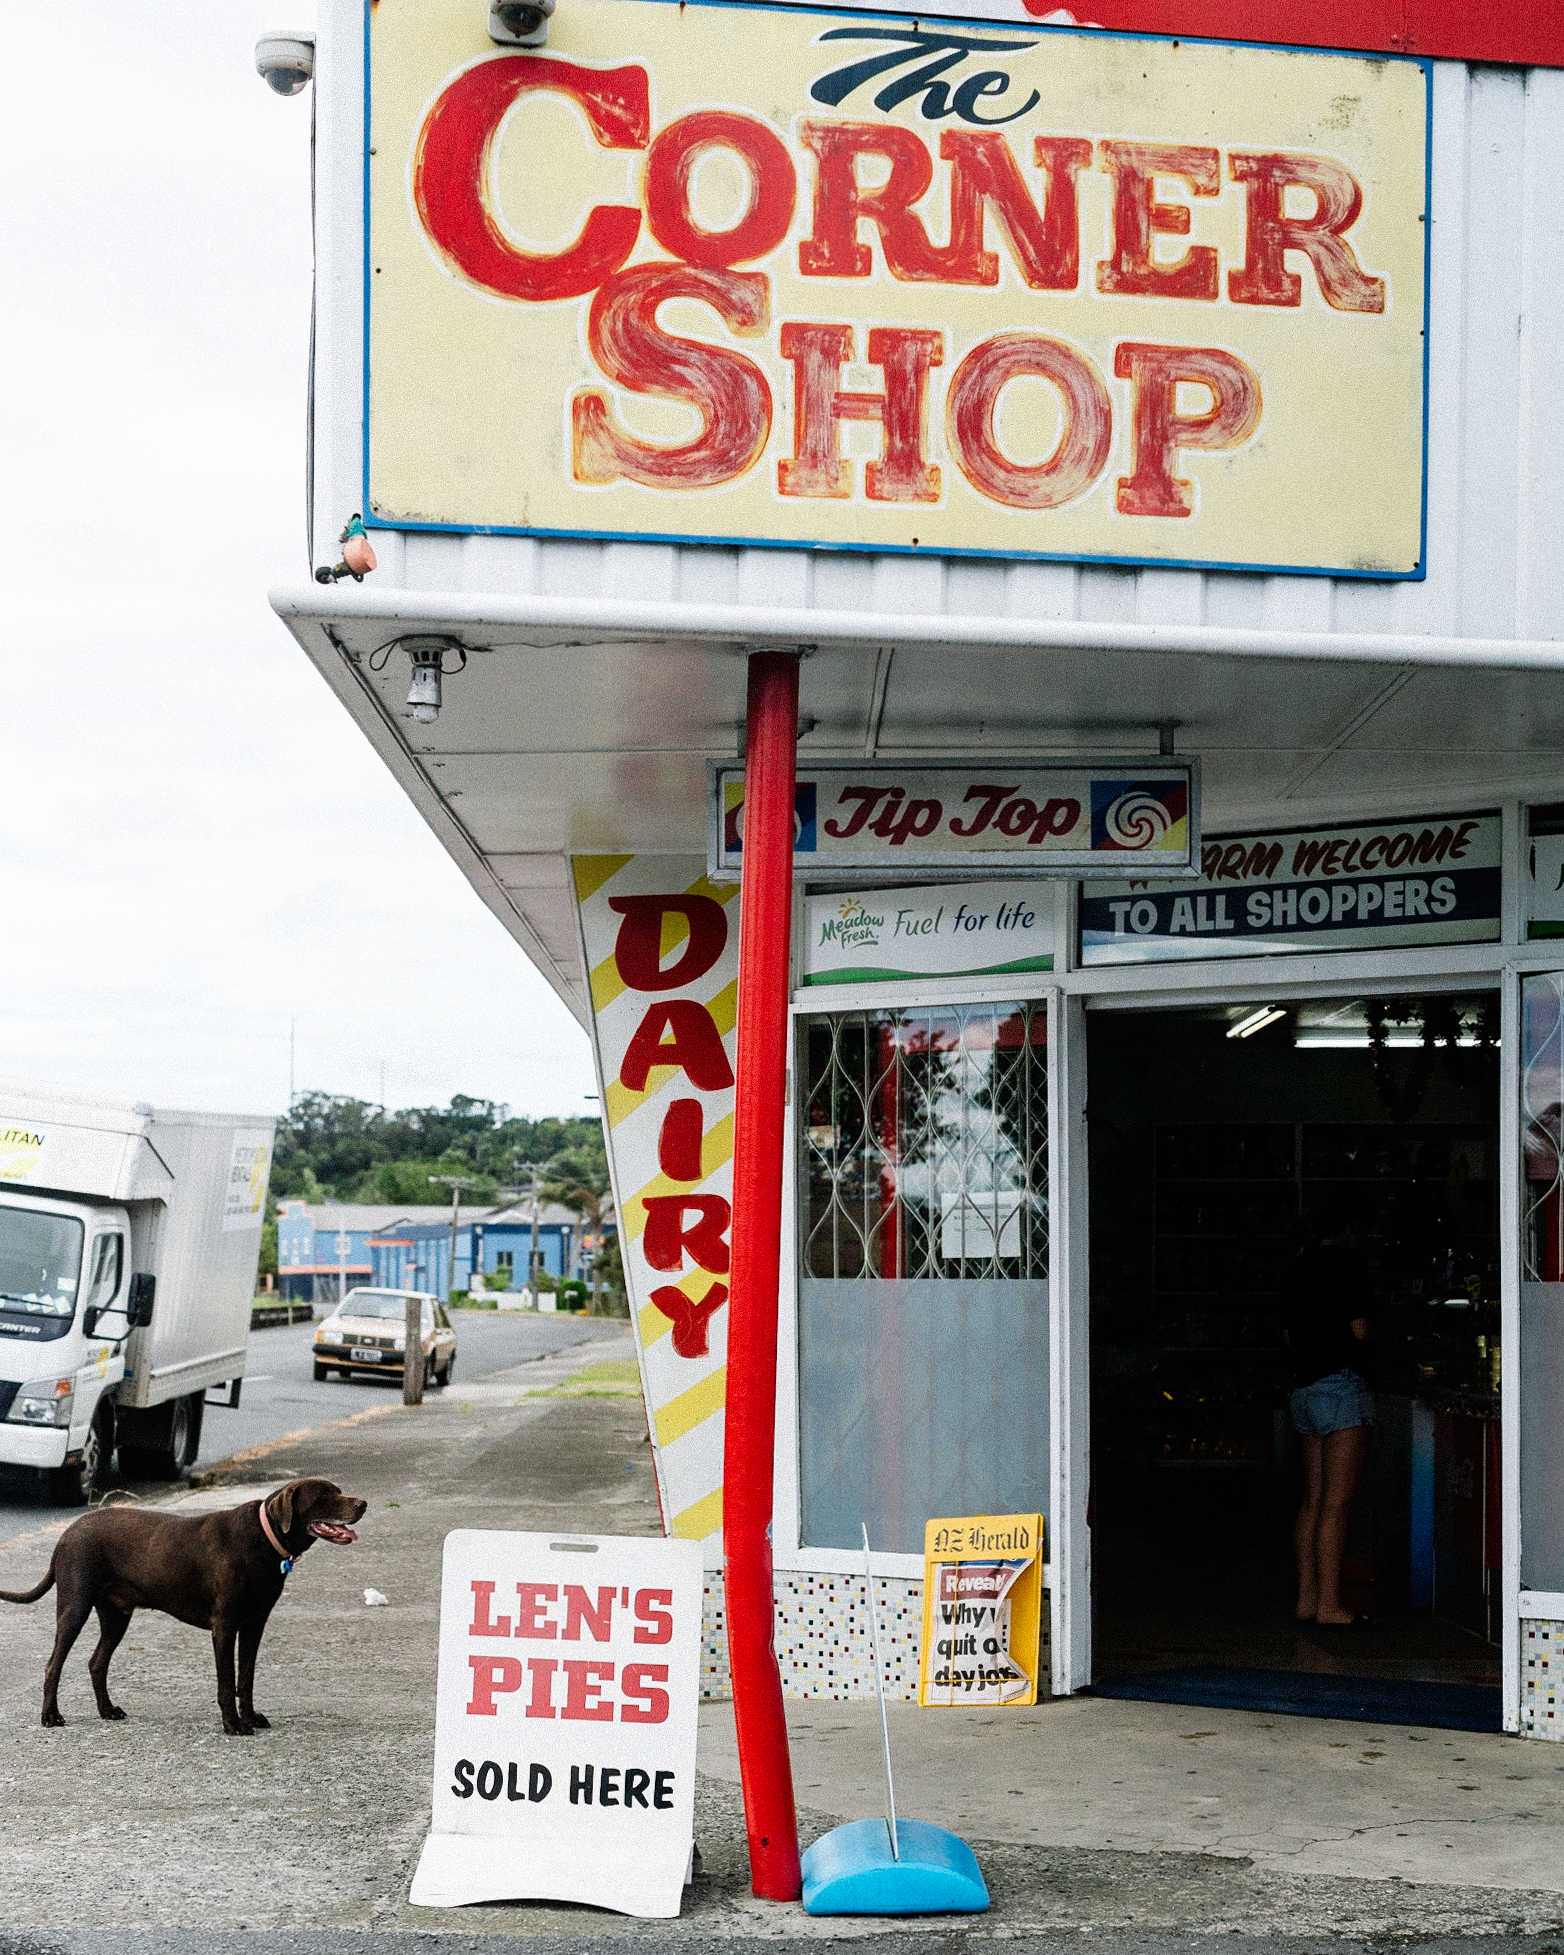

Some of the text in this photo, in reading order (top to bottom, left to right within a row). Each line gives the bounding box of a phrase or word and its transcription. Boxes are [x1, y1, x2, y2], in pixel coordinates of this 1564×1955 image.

[810, 27, 1041, 126] The
[413, 55, 1387, 313] CORNER
[571, 261, 1263, 518] SHOP
[823, 784, 1082, 845] Tip Top
[1201, 841, 1284, 883] ARM
[1291, 821, 1480, 877] WELCOME
[818, 909, 885, 947] Meadow
[893, 901, 1036, 938] Fuel for life
[1109, 877, 1457, 937] TO ALL SHOPPERS
[2, 1129, 46, 1146] ITAN
[608, 893, 735, 1359] DAIRY
[934, 1526, 1030, 1552] NZ Herald
[468, 1580, 673, 1645] LEN'S
[941, 1603, 987, 1628] Why
[937, 1632, 978, 1660] quit
[466, 1655, 670, 1724] PIES
[934, 1665, 976, 1692] day
[451, 1758, 676, 1810] SOLD HERE
